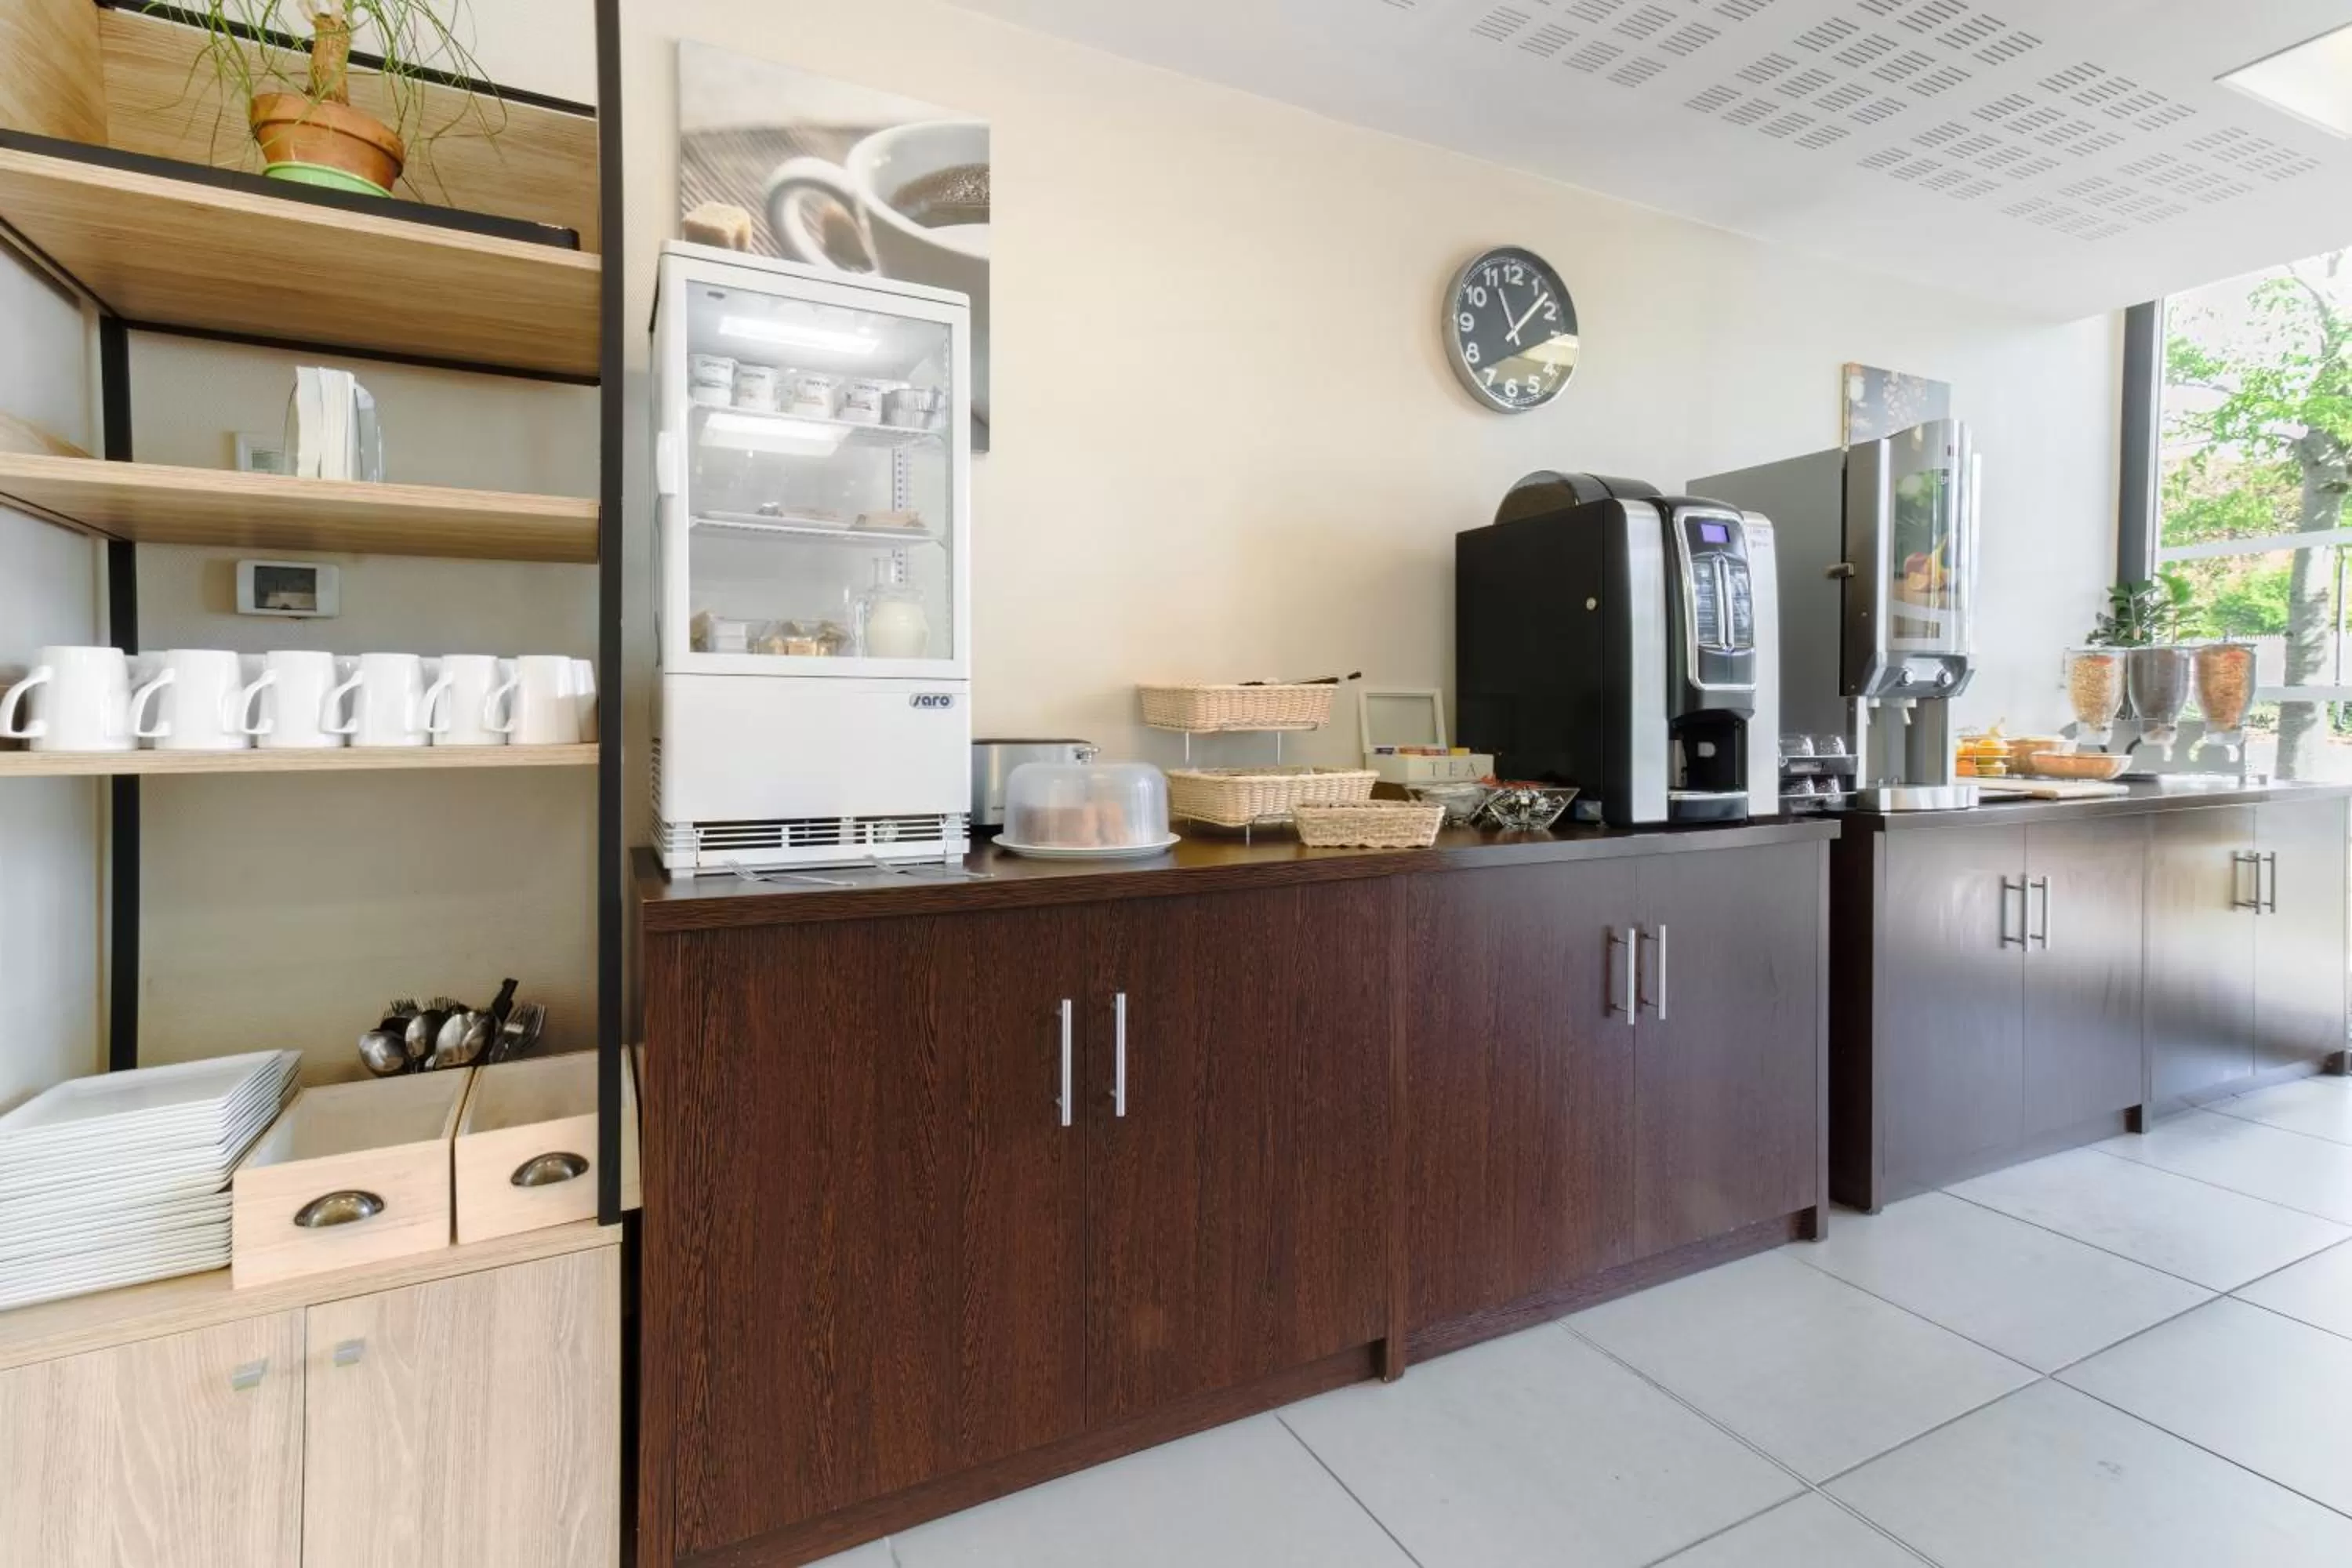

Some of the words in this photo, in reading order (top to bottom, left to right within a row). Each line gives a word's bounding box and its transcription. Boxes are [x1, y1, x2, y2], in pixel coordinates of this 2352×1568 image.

[1483, 267, 1498, 287] 11
[1503, 265, 1524, 285] 12
[1466, 285, 1487, 307] 10
[1531, 278, 1539, 296] 1
[1543, 302, 1556, 321] 2
[1459, 312, 1475, 332] 9
[1465, 342, 1480, 364] 8
[1543, 358, 1555, 376] 4
[1483, 368, 1497, 386] 7
[1527, 376, 1541, 394] 5
[1504, 379, 1519, 397] 6
[1428, 761, 1476, 777] TEA
